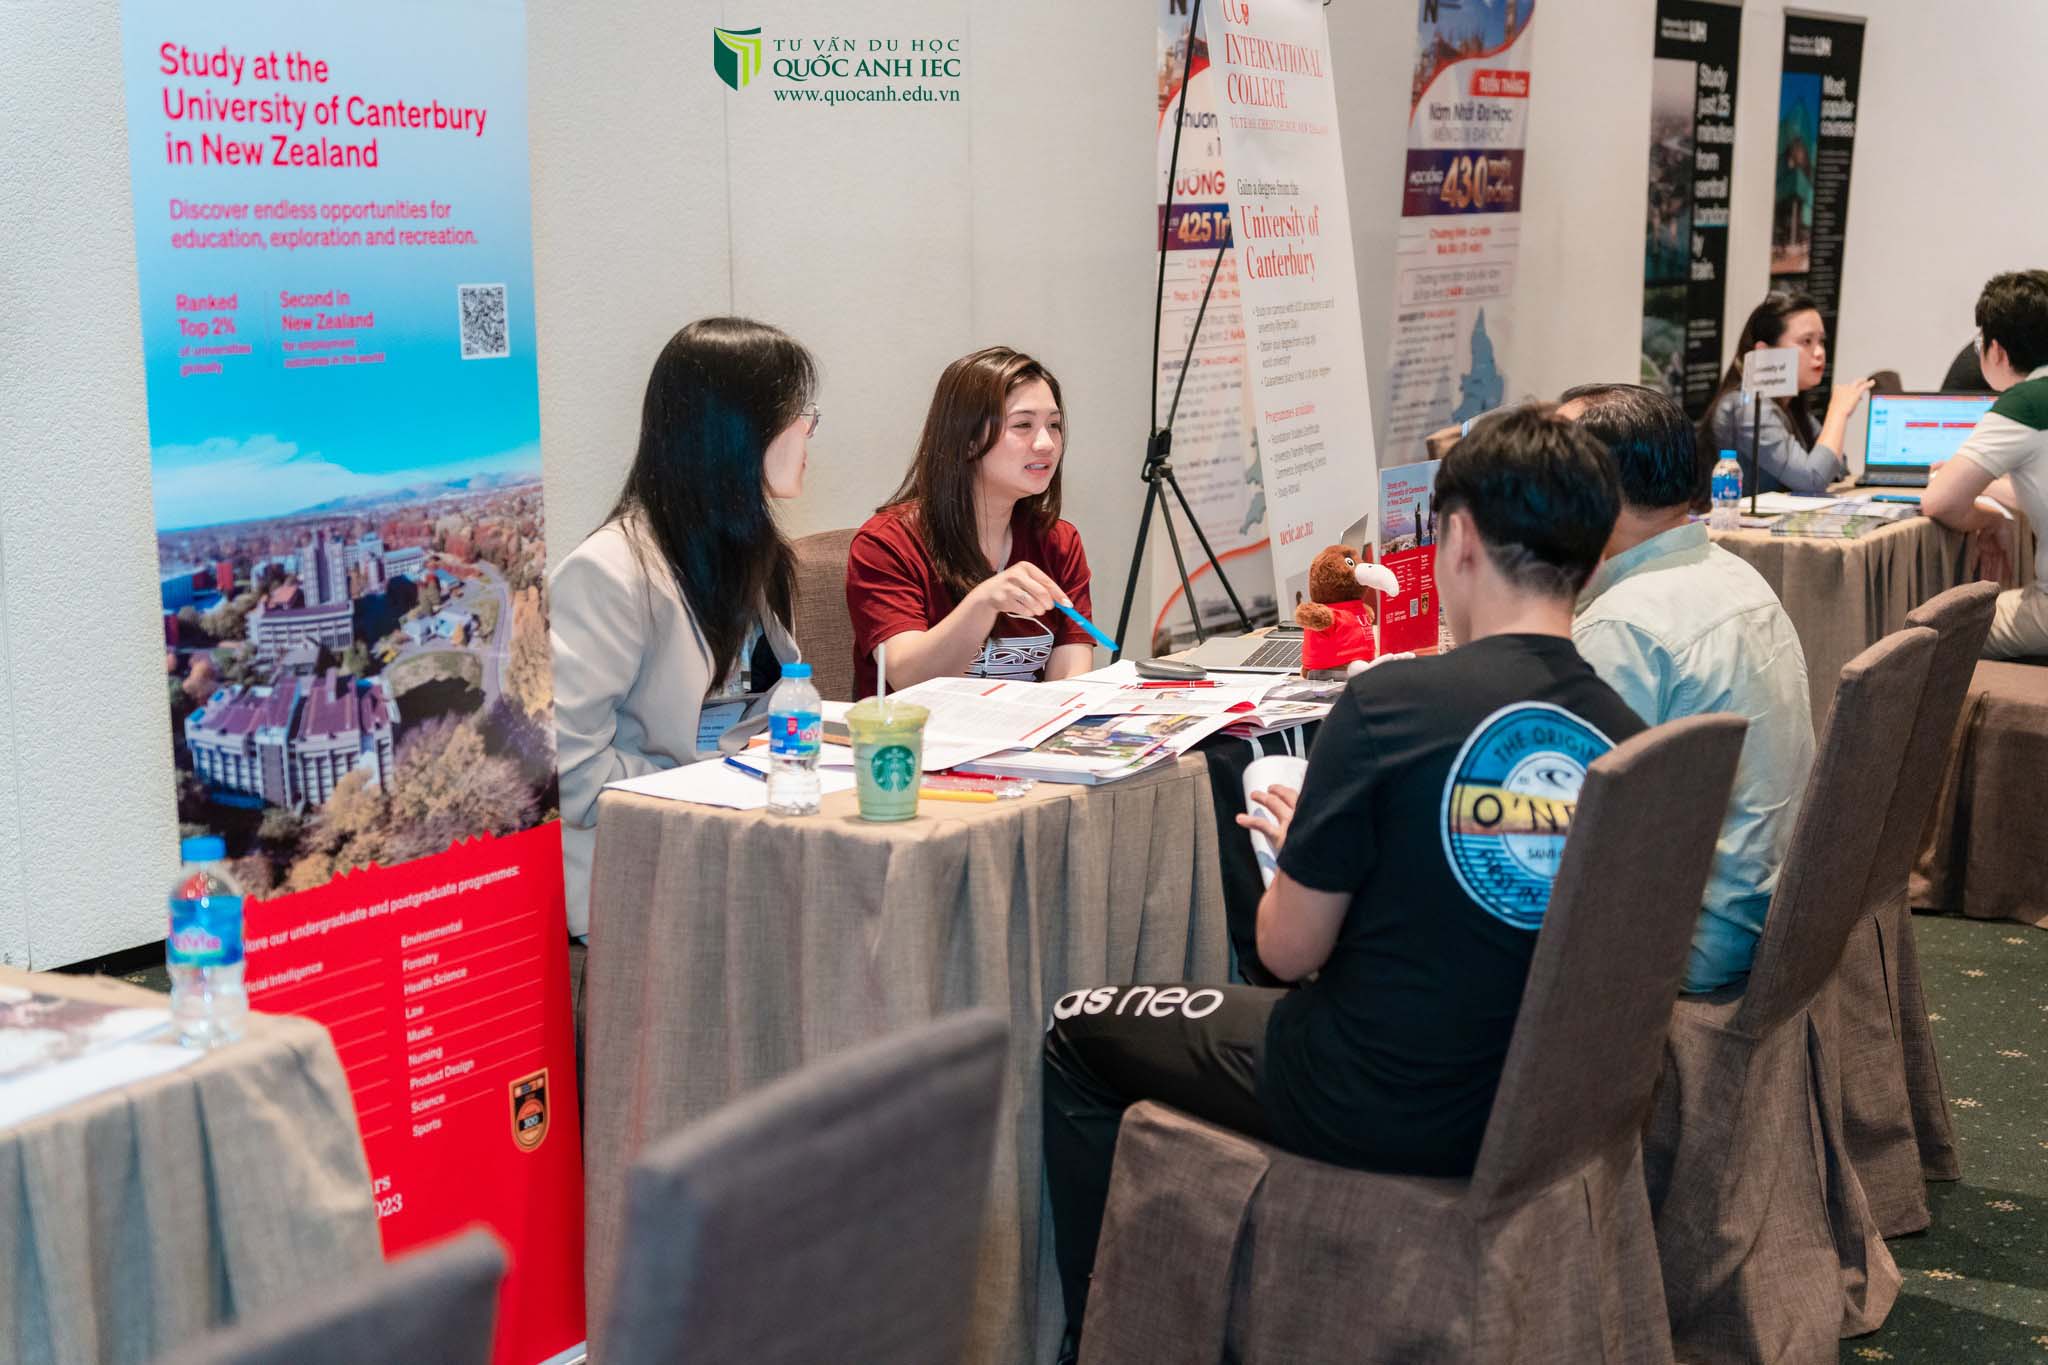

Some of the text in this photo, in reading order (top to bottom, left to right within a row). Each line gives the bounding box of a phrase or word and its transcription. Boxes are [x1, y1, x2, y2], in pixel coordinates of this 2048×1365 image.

[160, 42, 329, 86] Study at the
[1225, 33, 1324, 77] INTERNATIONAL
[1227, 72, 1288, 109] COLLEGE
[163, 87, 487, 137] University of Canterbury
[165, 132, 378, 168] in New Zealand
[1440, 155, 1488, 208] 430
[169, 199, 452, 223] Discover endless opportunities for
[1240, 204, 1319, 245] University of
[171, 226, 478, 251] education, exploration and recreation.
[1178, 211, 1213, 243] 425
[1246, 243, 1315, 282] Canterbury
[175, 292, 238, 312] Ranked
[279, 290, 351, 309] Second in
[177, 316, 236, 338] Top 2%
[281, 312, 375, 332] New Zealand
[1494, 726, 1597, 763] THE ORIGIN
[245, 936, 269, 953] lore
[269, 931, 289, 947] our
[289, 908, 368, 940] undergraduate
[368, 898, 390, 918] and
[390, 882, 457, 914] postgraduate
[401, 918, 463, 948] Environmental
[269, 961, 324, 986] Intelligence
[402, 953, 439, 972] Forestry
[403, 968, 468, 997] Health Science
[404, 1005, 424, 1020] Law
[1115, 985, 1225, 1019] neo
[406, 1025, 434, 1043] Music
[408, 1046, 443, 1068] Nursing
[409, 1059, 475, 1091] Product Design
[410, 1093, 446, 1114] Science
[412, 1118, 442, 1137] Sports
[375, 1193, 403, 1218] 023
